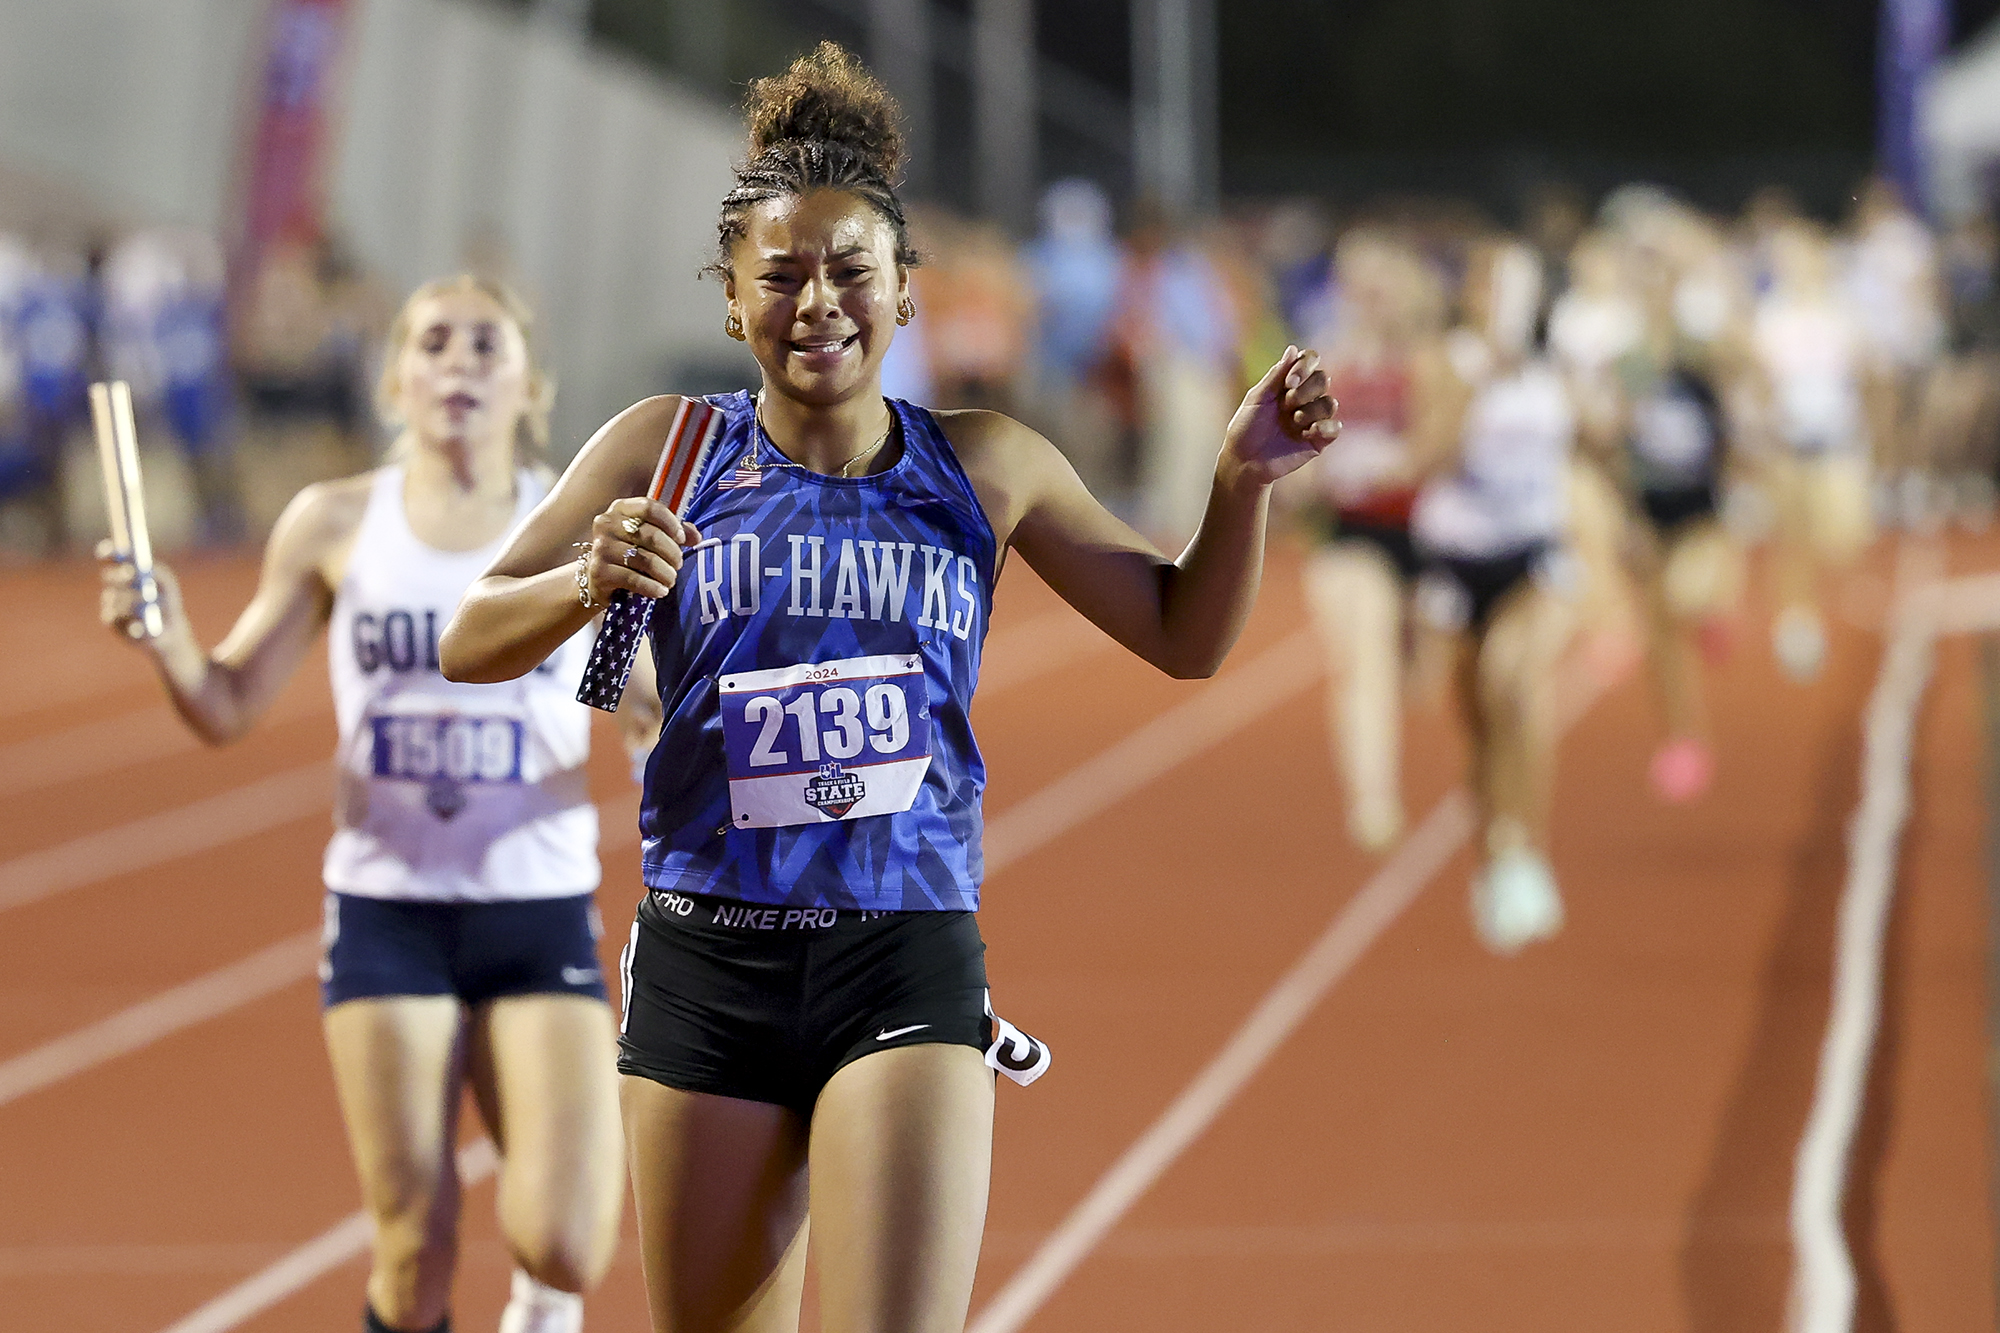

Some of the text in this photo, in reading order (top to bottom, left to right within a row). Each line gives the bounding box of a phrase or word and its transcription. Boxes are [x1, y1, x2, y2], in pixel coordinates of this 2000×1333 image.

[693, 533, 977, 641] RO-HAWKS
[805, 668, 839, 680] 2024
[744, 683, 910, 767] 2139
[388, 718, 513, 778] 1509
[805, 782, 864, 802] STATE
[712, 905, 779, 929] NIKE
[781, 908, 837, 930] PRO
